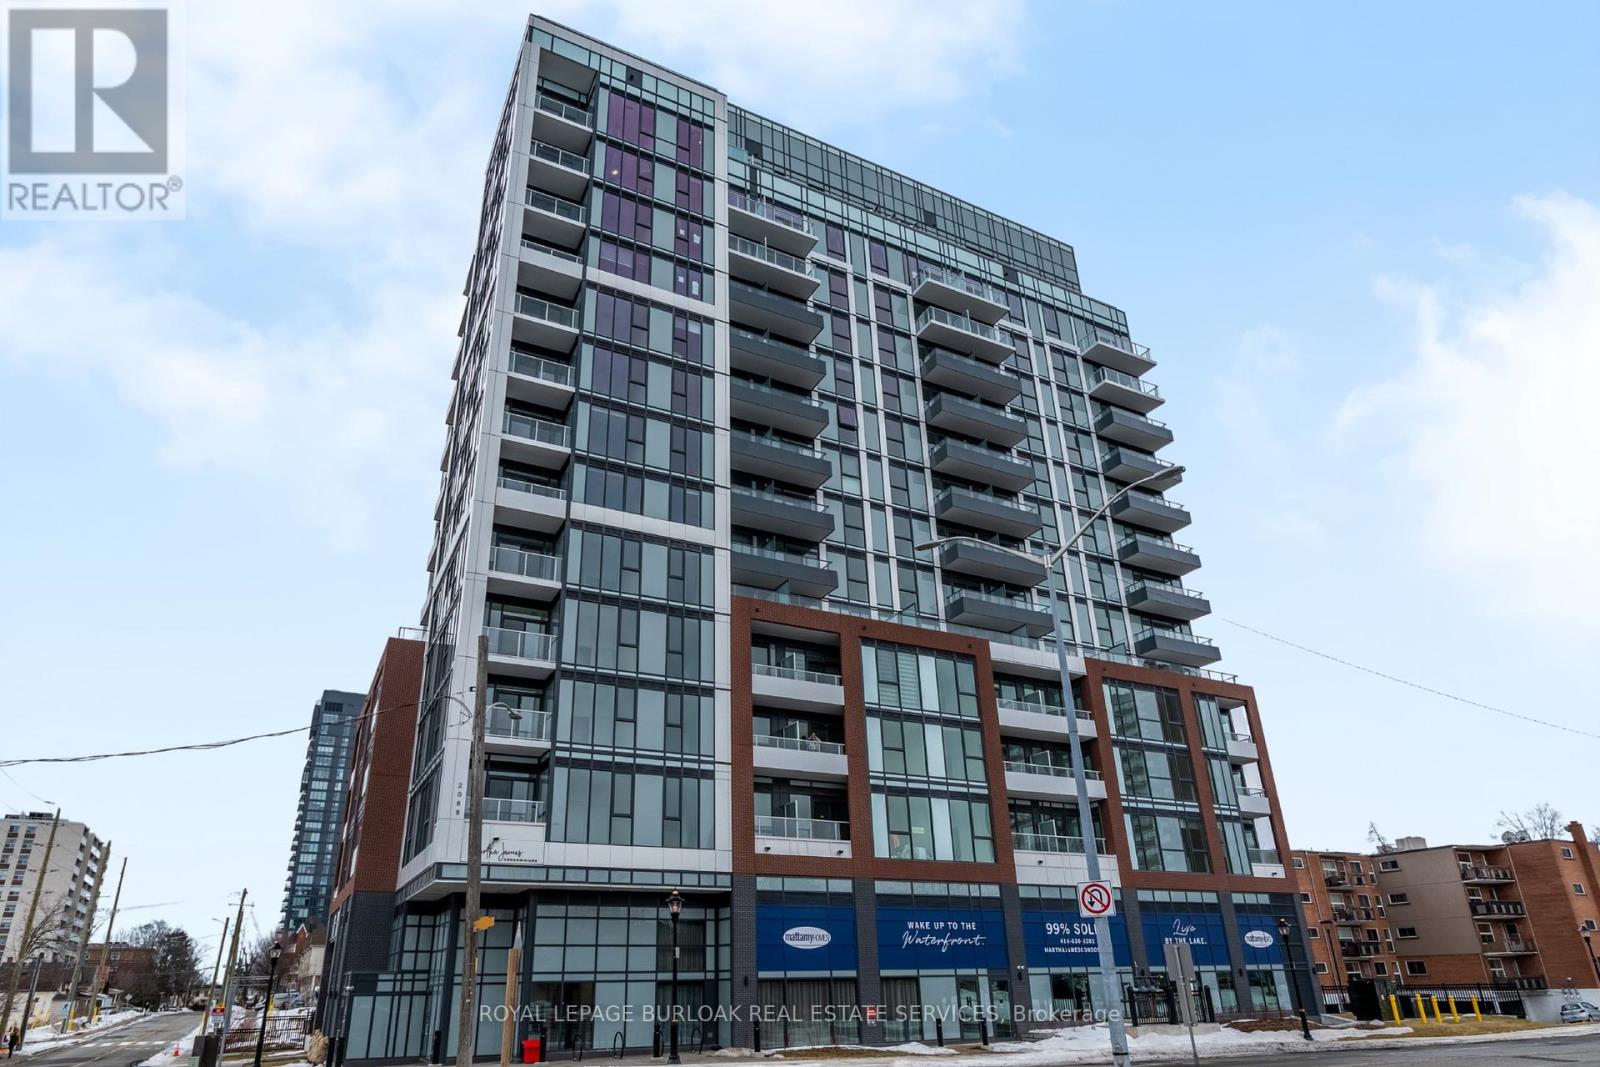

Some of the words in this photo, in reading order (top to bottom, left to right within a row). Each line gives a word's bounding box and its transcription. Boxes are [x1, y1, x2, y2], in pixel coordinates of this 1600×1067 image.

[907, 921, 931, 930] WAKE
[933, 921, 945, 930] UP
[947, 921, 958, 930] TO
[960, 922, 977, 930] THE
[1045, 922, 1071, 935] 99%
[1164, 937, 1173, 945] BY
